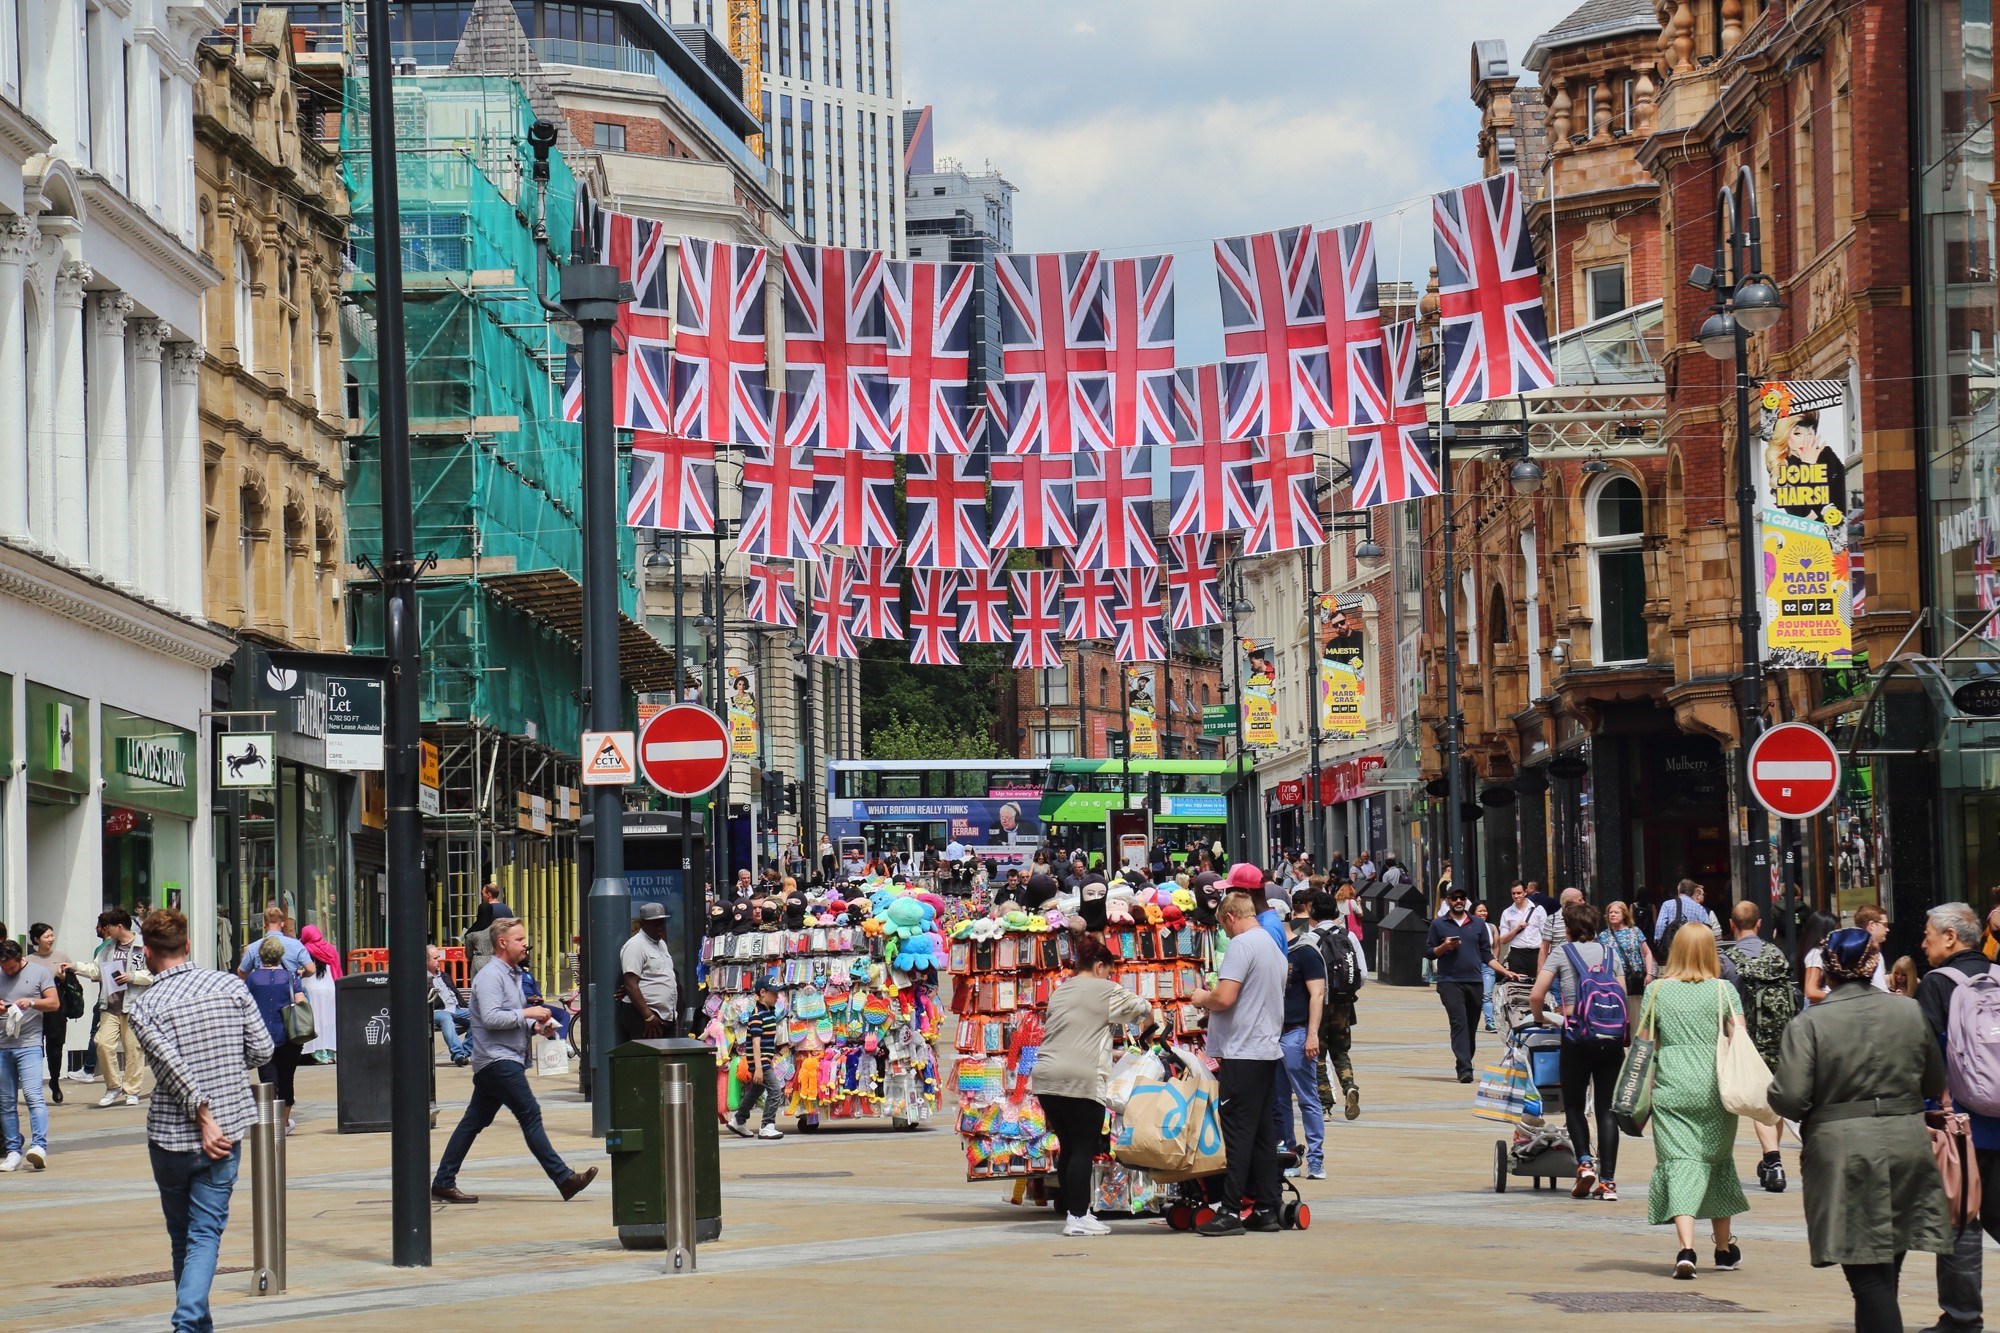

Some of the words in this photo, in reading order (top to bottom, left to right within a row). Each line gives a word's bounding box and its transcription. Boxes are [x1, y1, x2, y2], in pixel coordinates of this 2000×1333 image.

[1801, 399, 1832, 412] MARDI
[1834, 396, 1842, 405] G
[1778, 464, 1828, 485] JODIE
[1776, 485, 1829, 506] HARSH
[1772, 515, 1807, 531] GRAS
[1939, 503, 1981, 554] HARVEY
[1783, 572, 1830, 582] MARDI
[1787, 584, 1827, 594] GRAS
[1784, 604, 1796, 612] 02
[1802, 603, 1813, 611] 07
[1819, 603, 1831, 611] 22
[1778, 620, 1839, 628] ROUNDHAY
[1810, 628, 1841, 636] LEEDS
[329, 682, 346, 697] To
[329, 697, 351, 712] Let
[127, 737, 160, 780] LLOYDS
[162, 747, 186, 787] BANK
[1666, 755, 1708, 771] Mulberry
[868, 806, 888, 814] WHAT
[890, 806, 915, 814] BRITAIN
[918, 805, 942, 814] REALLY
[943, 805, 968, 814] THINKS
[953, 819, 967, 827] NICK
[953, 827, 978, 835] FERRARI
[656, 876, 674, 885] THE
[652, 887, 672, 896] WAY
[753, 939, 761, 953] ICON
[1633, 1045, 1647, 1070] eden
[1621, 1071, 1639, 1106] project
